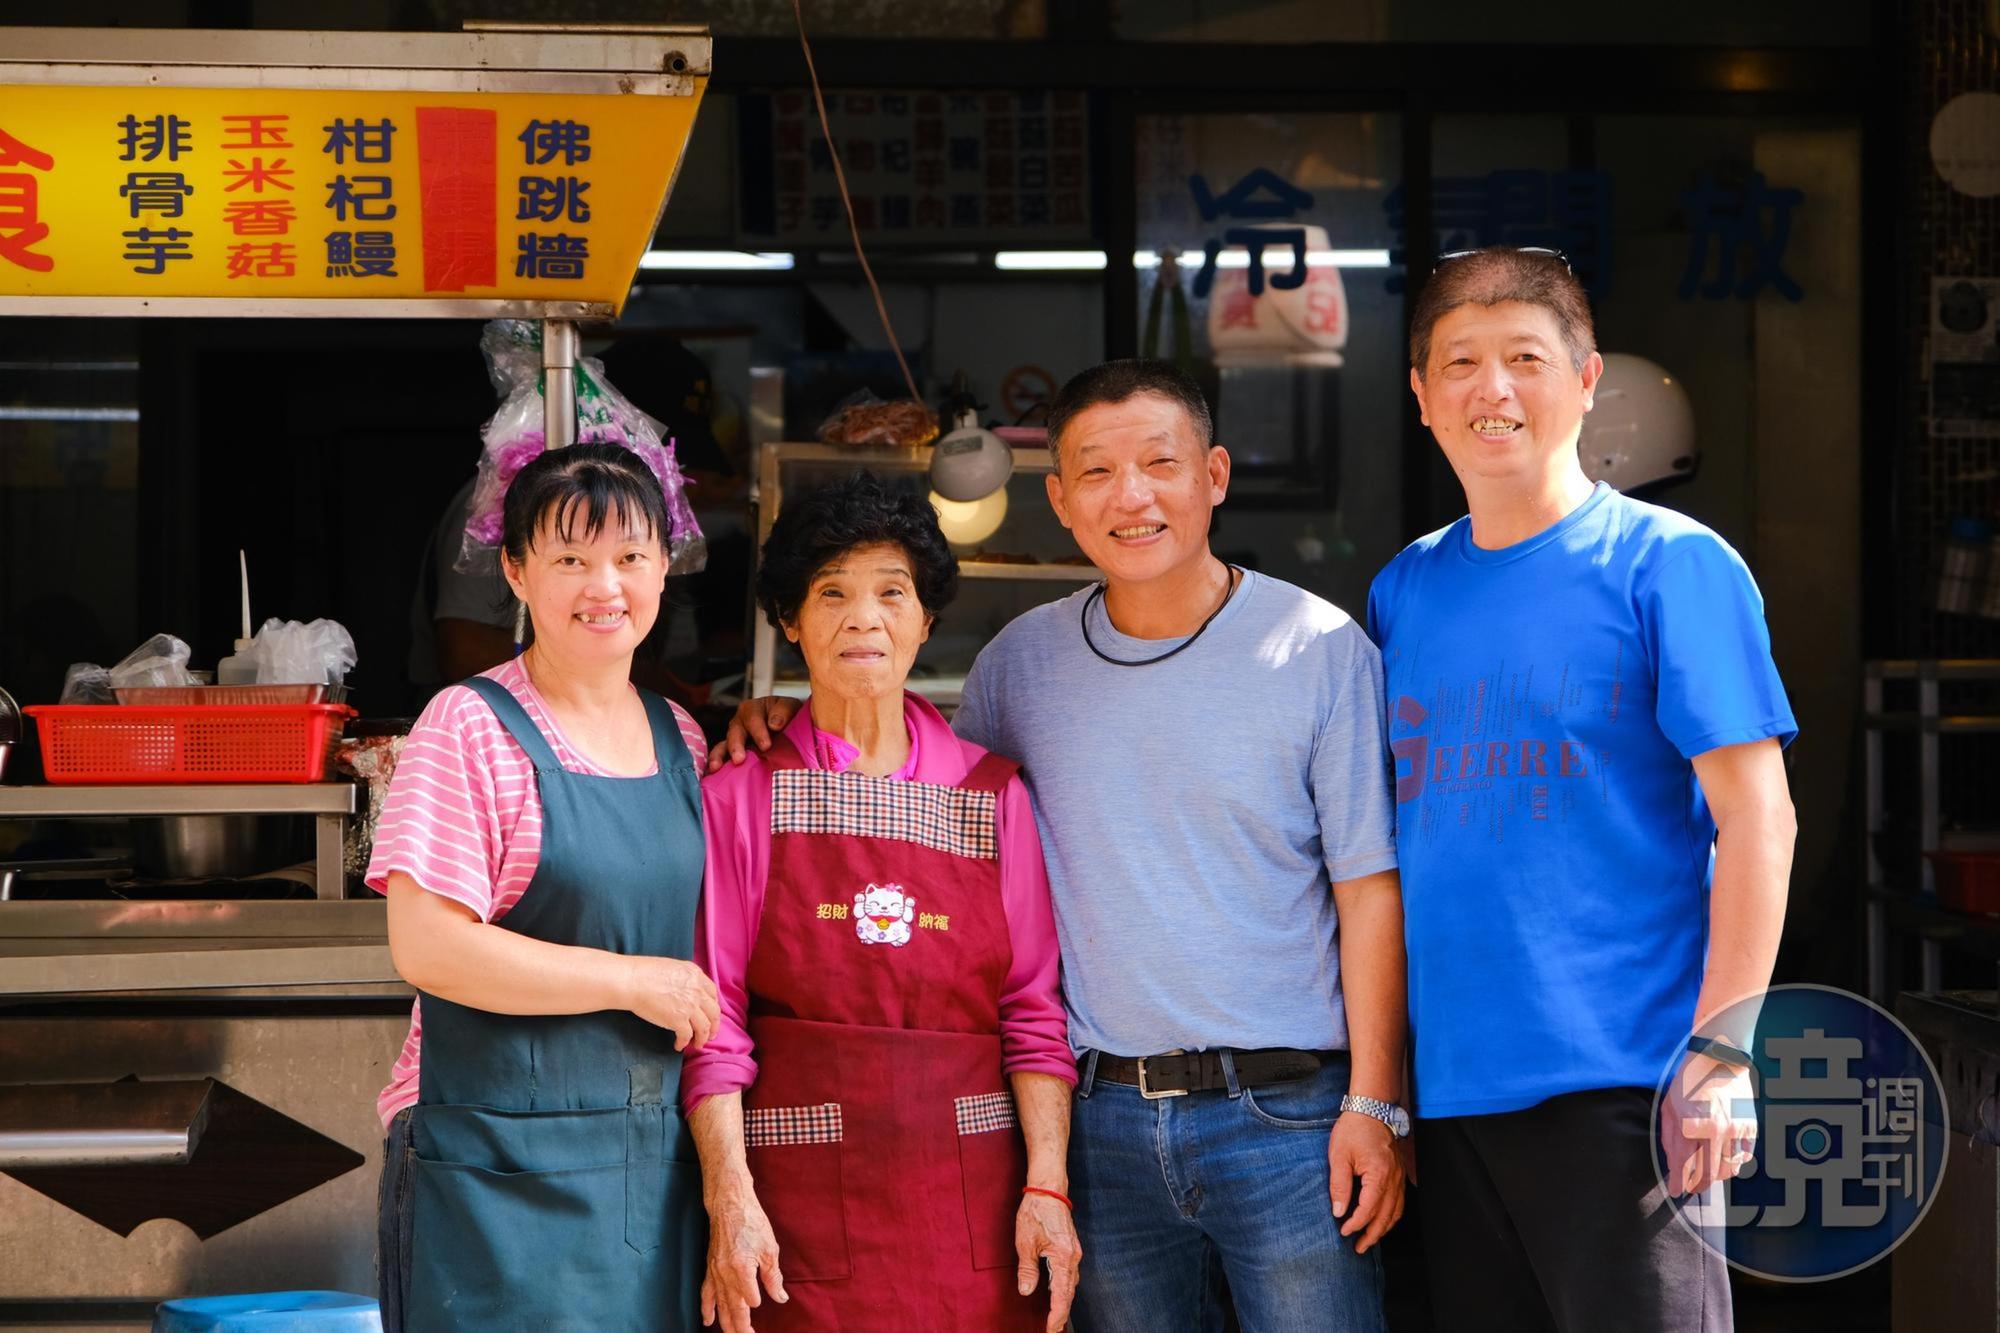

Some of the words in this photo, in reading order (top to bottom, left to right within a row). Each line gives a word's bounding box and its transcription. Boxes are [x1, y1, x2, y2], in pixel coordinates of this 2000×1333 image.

[117, 113, 194, 275] 排骨芋
[219, 114, 298, 280] 玉米香菇
[322, 116, 400, 279] 柑杞鰻
[515, 118, 593, 281] 佛跳牆
[816, 903, 849, 920] 招財
[918, 911, 950, 931] 納福
